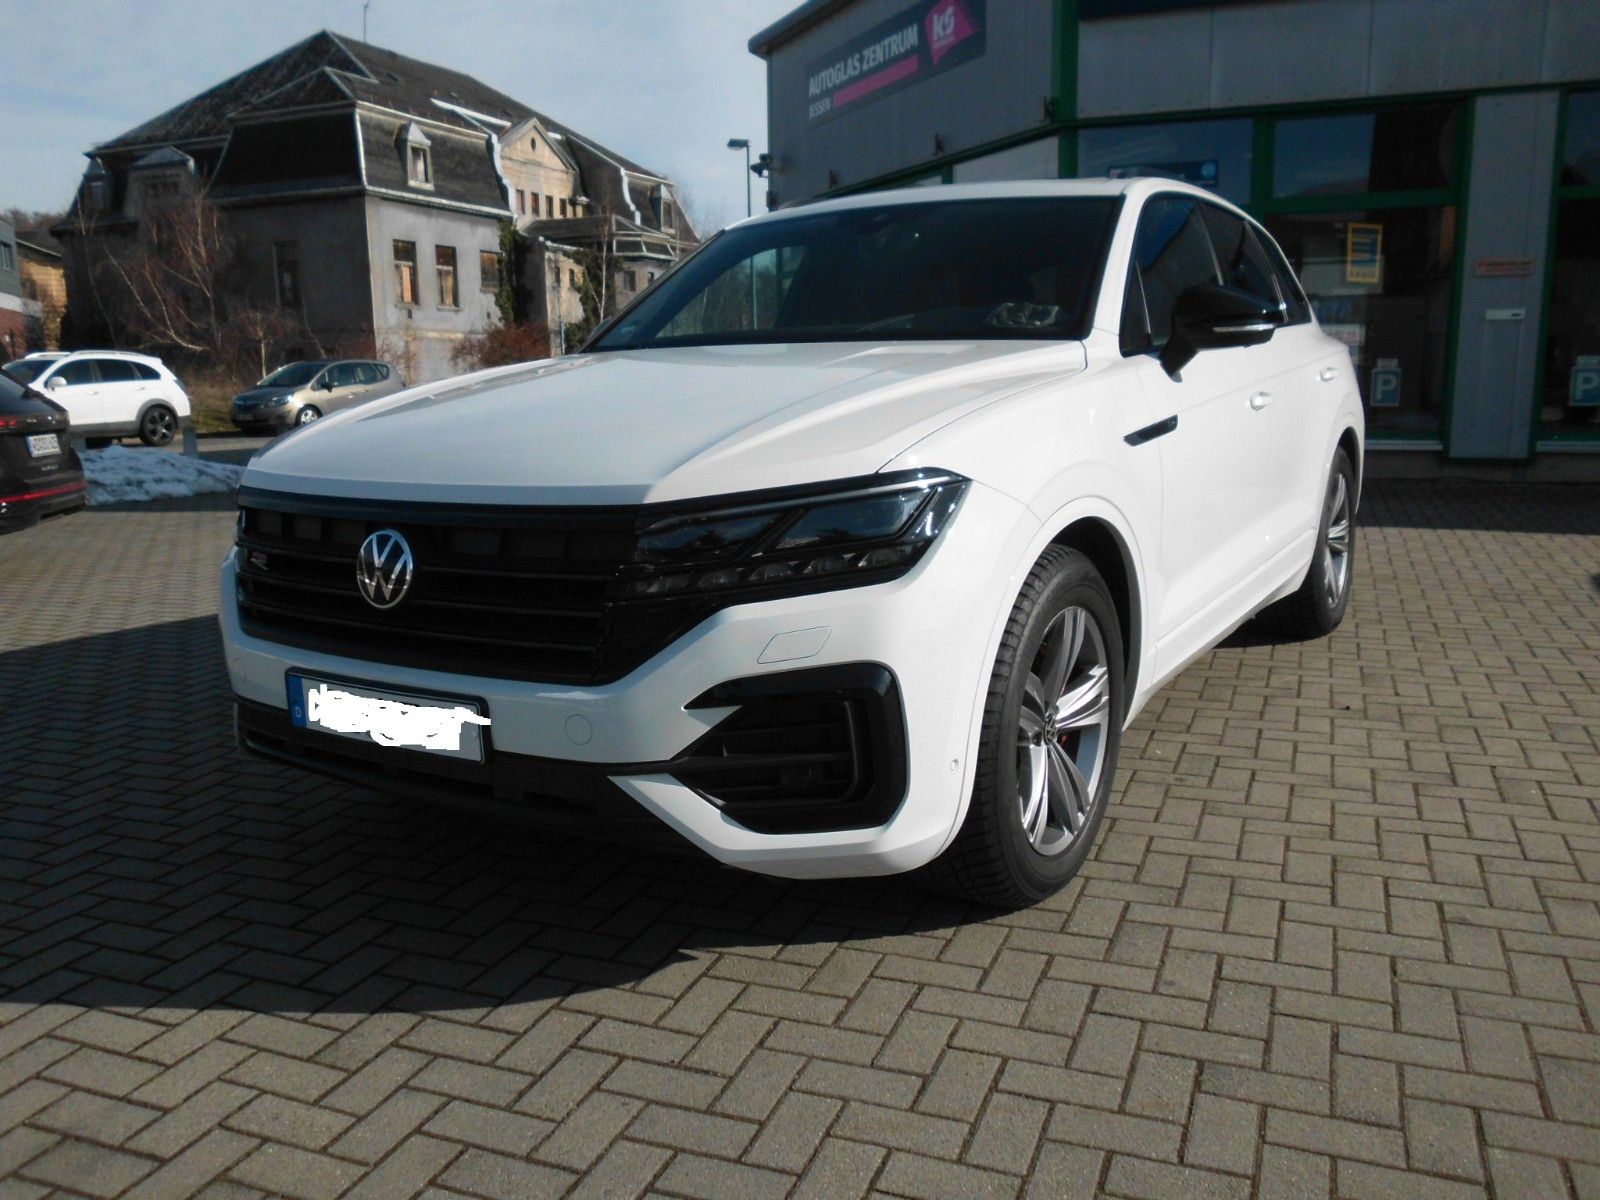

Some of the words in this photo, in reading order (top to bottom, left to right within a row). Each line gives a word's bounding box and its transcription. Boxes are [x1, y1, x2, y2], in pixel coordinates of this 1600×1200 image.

[808, 53, 861, 97] AUTOGLAS
[862, 23, 919, 71] ZENTRUM
[1377, 373, 1397, 400] P
[1577, 371, 1599, 400] P
[357, 528, 414, 610] VW
